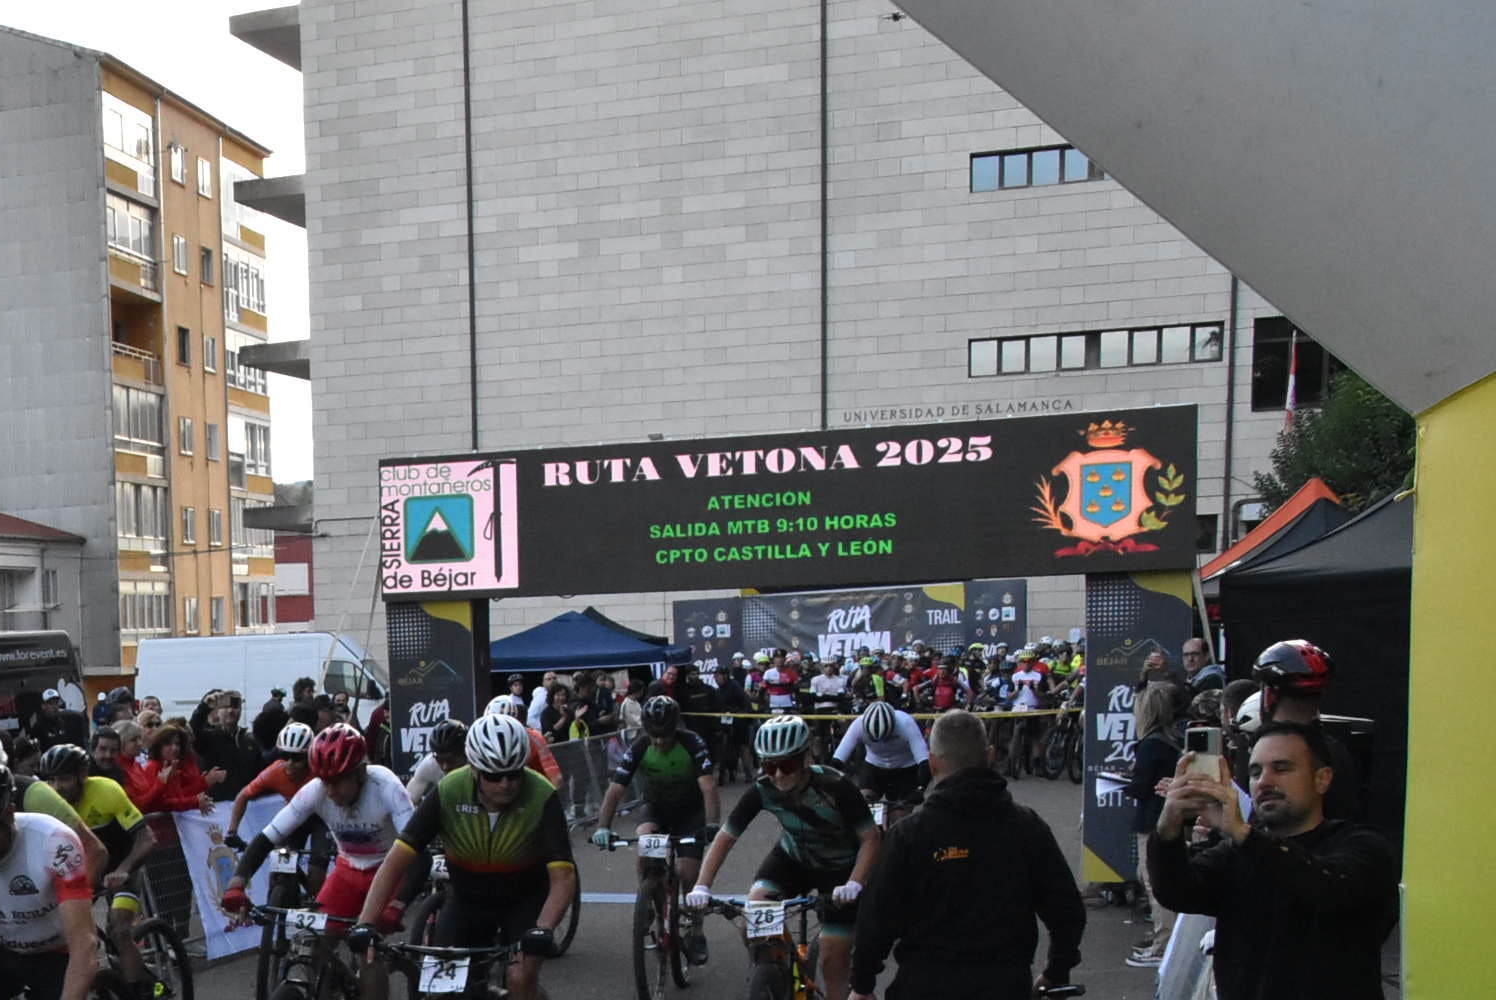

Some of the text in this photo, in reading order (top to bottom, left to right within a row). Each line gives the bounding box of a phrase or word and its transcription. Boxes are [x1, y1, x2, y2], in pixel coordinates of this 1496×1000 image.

[843, 399, 1074, 423] UNIVERSIDAD DE SALAMANCA
[380, 463, 451, 482] club de
[542, 435, 994, 487] RUTA VETONA 2025
[381, 477, 492, 497] montañeros
[382, 499, 402, 570] SIERRA
[649, 512, 897, 540] SALIDA MTB 9:10 HORAS
[655, 537, 894, 565] CPTO CASTILLA Y LEÓN
[382, 567, 477, 591] de Béjar
[827, 604, 872, 634] RUTA
[926, 608, 962, 626] TRAIL
[1107, 683, 1137, 713] RU
[408, 698, 451, 728] RUTA
[1096, 712, 1138, 741] VET
[645, 837, 660, 850] 30
[295, 913, 317, 931] 32
[754, 909, 774, 924] 26
[433, 958, 457, 980] 24
